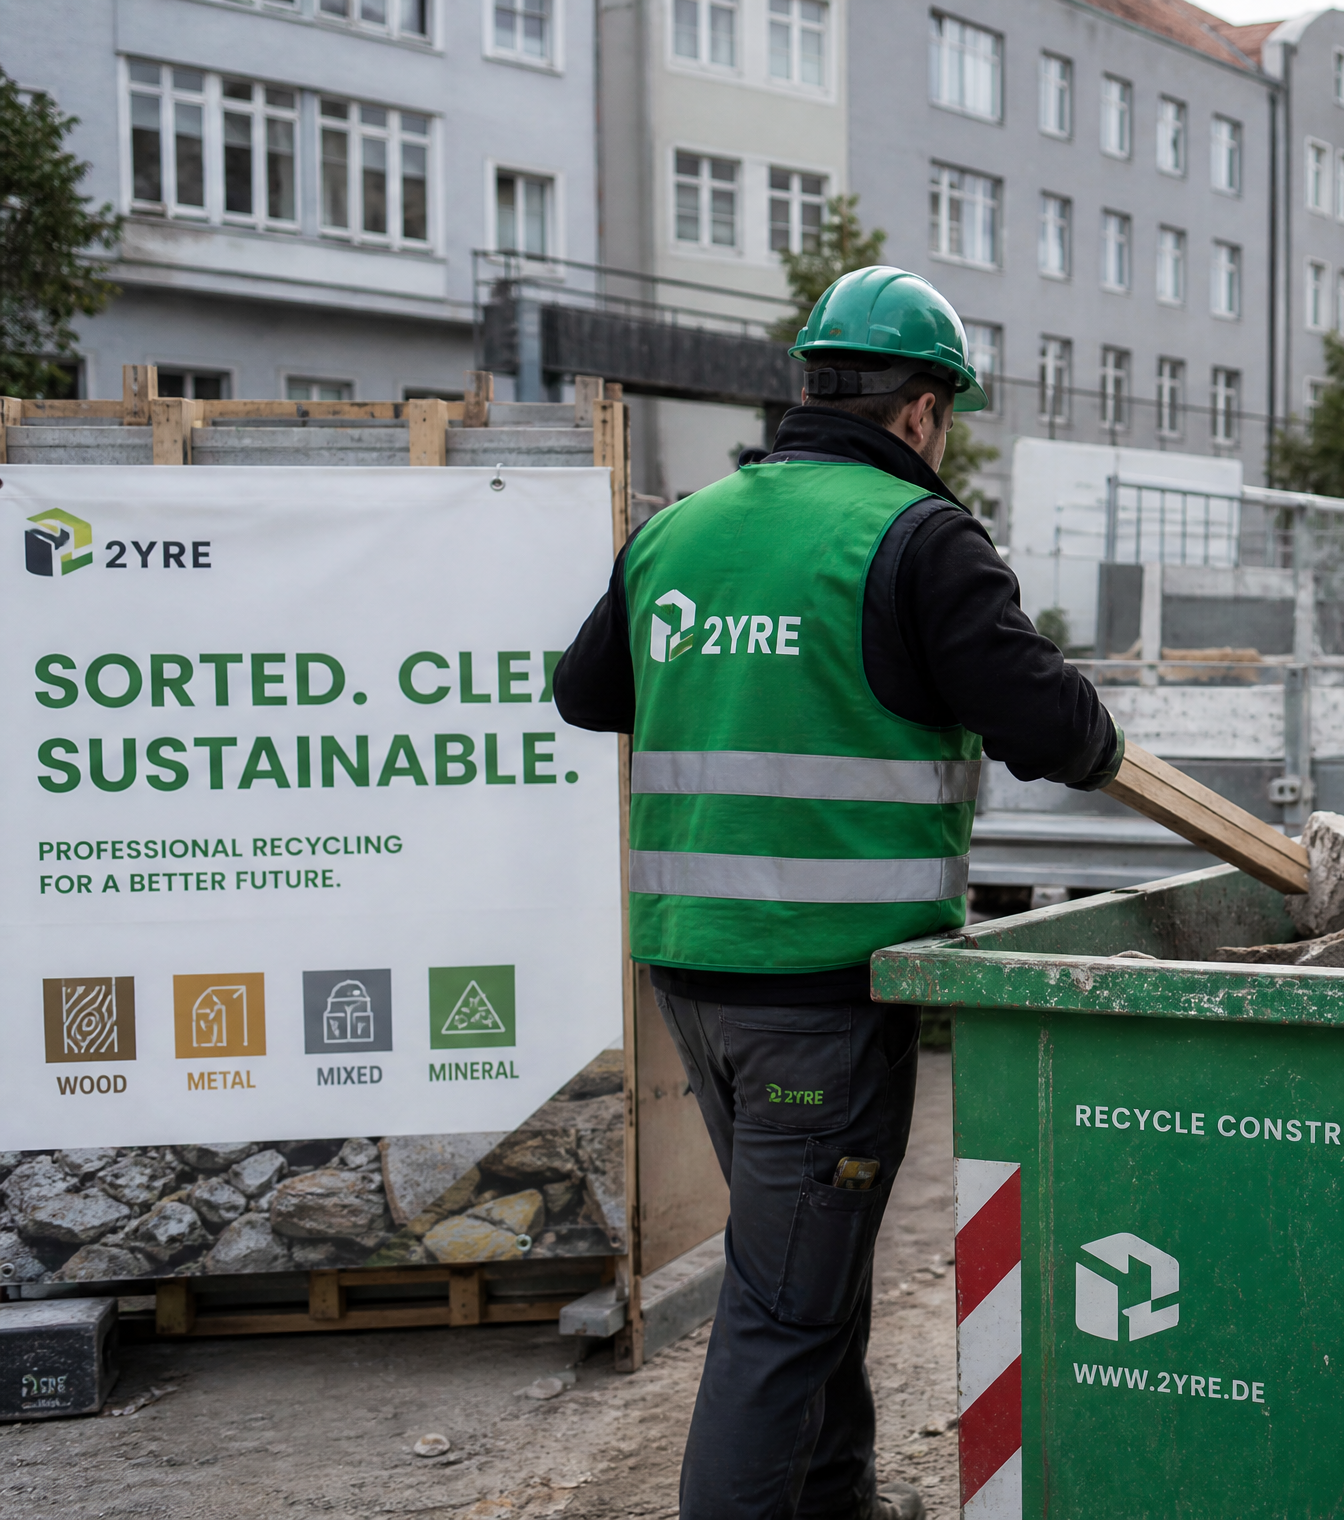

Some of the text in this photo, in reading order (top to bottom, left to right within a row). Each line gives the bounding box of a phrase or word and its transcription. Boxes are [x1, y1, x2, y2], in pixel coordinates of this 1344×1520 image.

[104, 539, 212, 569] 2YRE
[700, 615, 802, 656] 2YRE
[34, 651, 368, 709] SORTED.
[36, 731, 580, 794] SUSTAINABLE.
[38, 834, 403, 862] PROFESSIONAL RECYCLING
[39, 868, 342, 895] FOR A BETTER FUTURE.
[56, 1074, 128, 1096] WOOD
[187, 1069, 257, 1092] METAL
[316, 1065, 383, 1087] MIXED
[428, 1059, 520, 1083] MINERAL
[784, 1090, 824, 1105] 2YRE
[1075, 1104, 1206, 1136] RECYCLE
[1072, 1362, 1266, 1404] WWW.2YRE.DE
